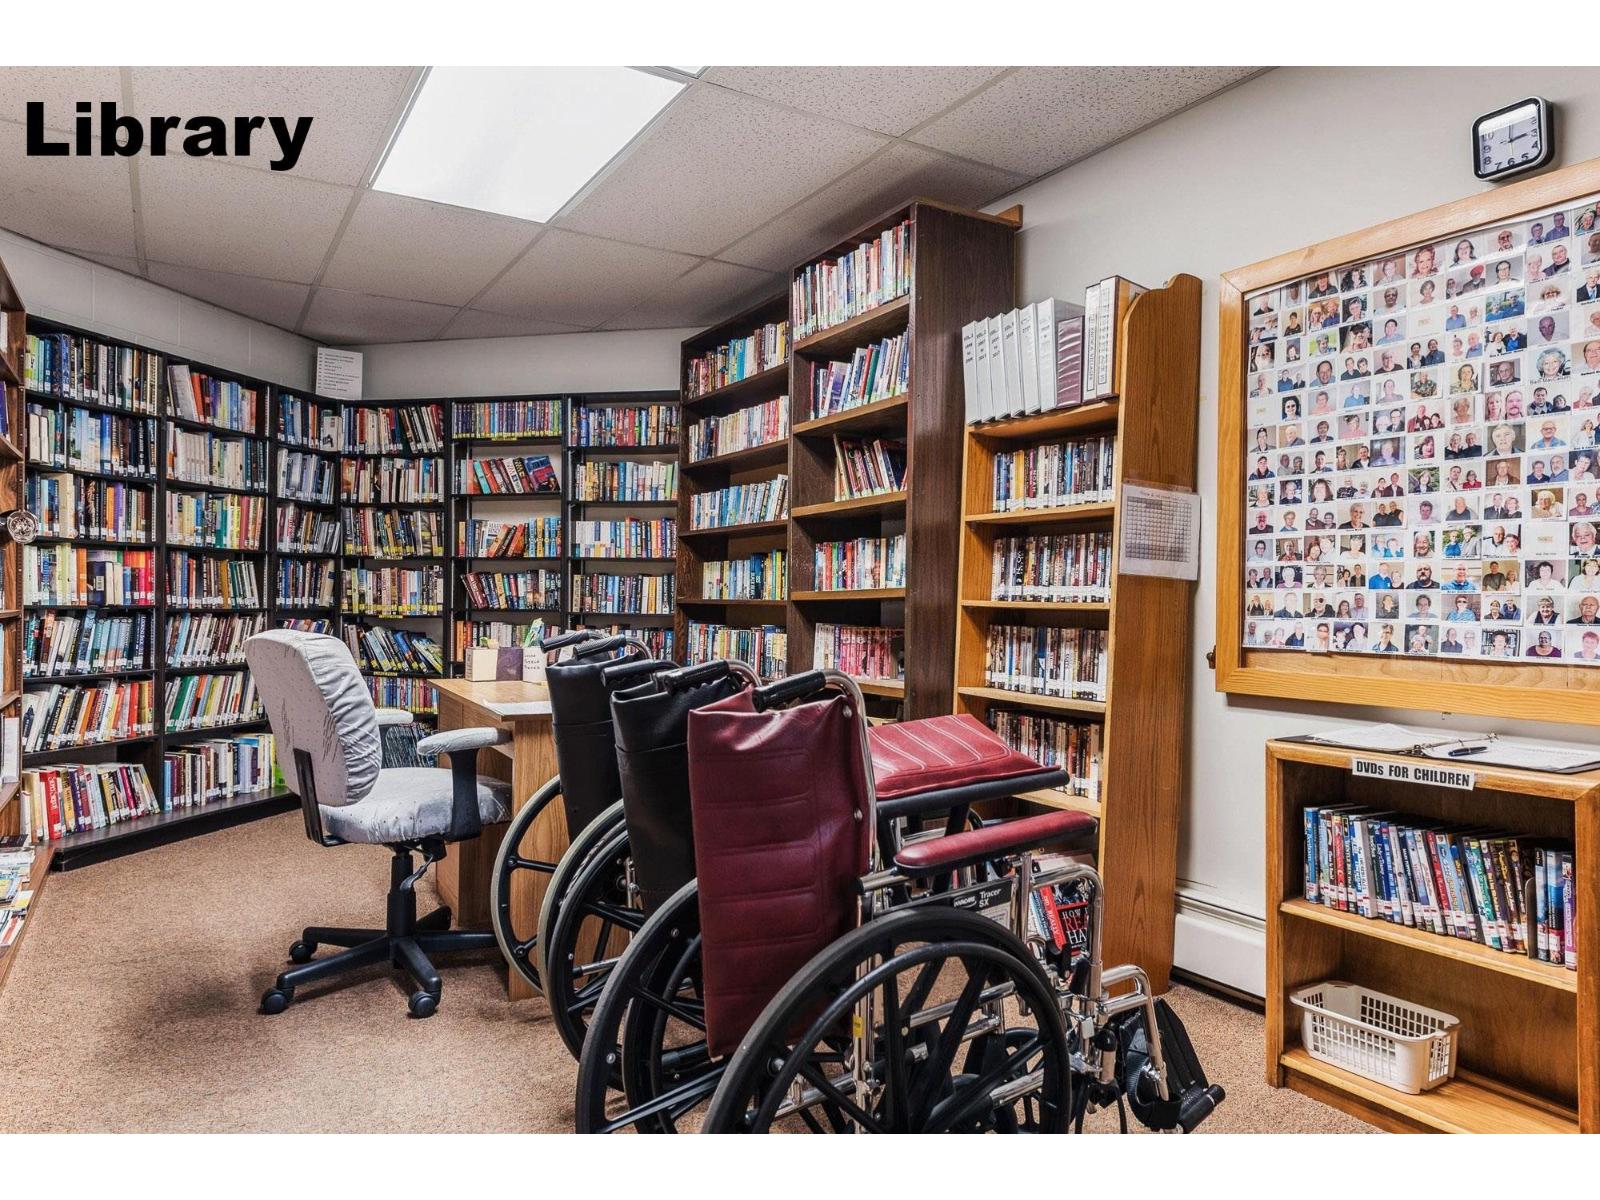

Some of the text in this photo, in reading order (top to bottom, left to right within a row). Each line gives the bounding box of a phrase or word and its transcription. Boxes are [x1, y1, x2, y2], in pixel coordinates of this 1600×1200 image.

[1530, 128, 1538, 138] 3
[1531, 140, 1539, 149] 4
[1507, 157, 1516, 167] 6
[1521, 152, 1529, 162] 5
[1495, 161, 1502, 171] 7
[1356, 760, 1470, 787] DVDs FOR CHILDREN
[979, 888, 1001, 900] Tracer
[978, 898, 989, 908] SX
[1061, 909, 1081, 919] HOW
